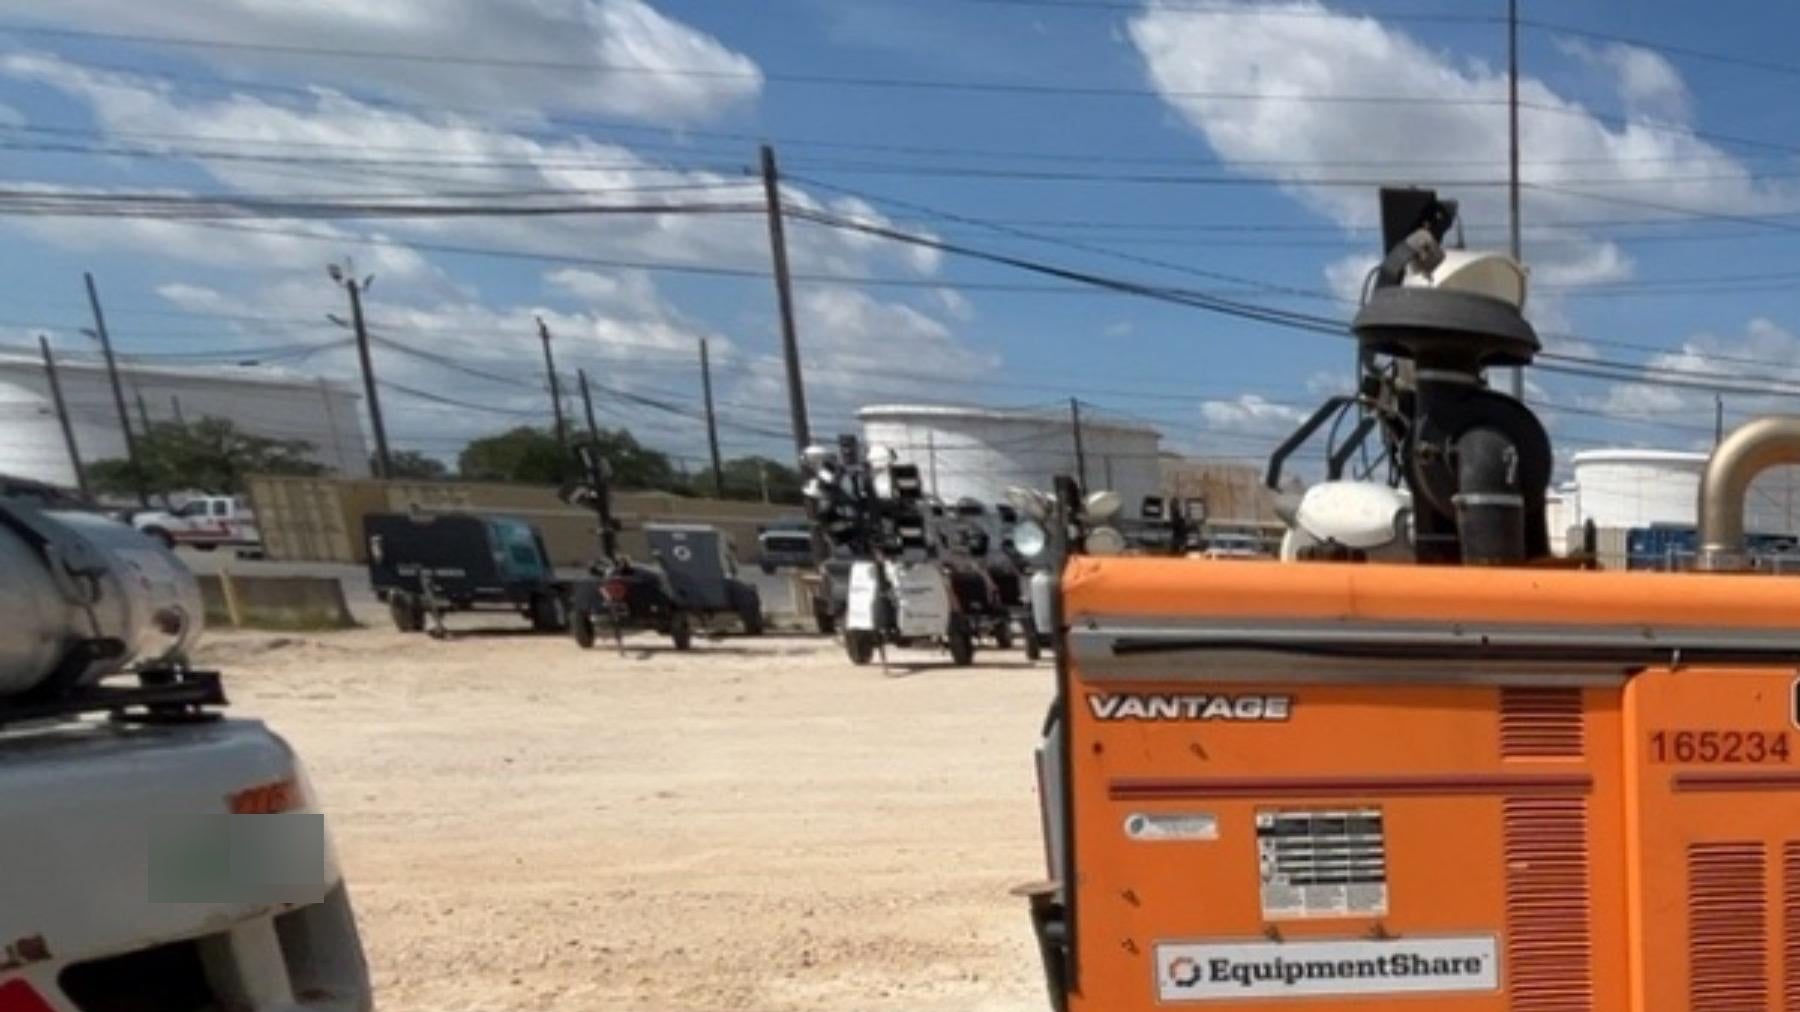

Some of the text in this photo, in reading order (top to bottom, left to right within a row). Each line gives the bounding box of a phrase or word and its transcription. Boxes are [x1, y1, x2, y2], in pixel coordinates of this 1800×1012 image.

[1087, 694, 1290, 719] VANTAGE
[1650, 731, 1790, 763] 165234
[1208, 953, 1482, 987] EquipmentShare
